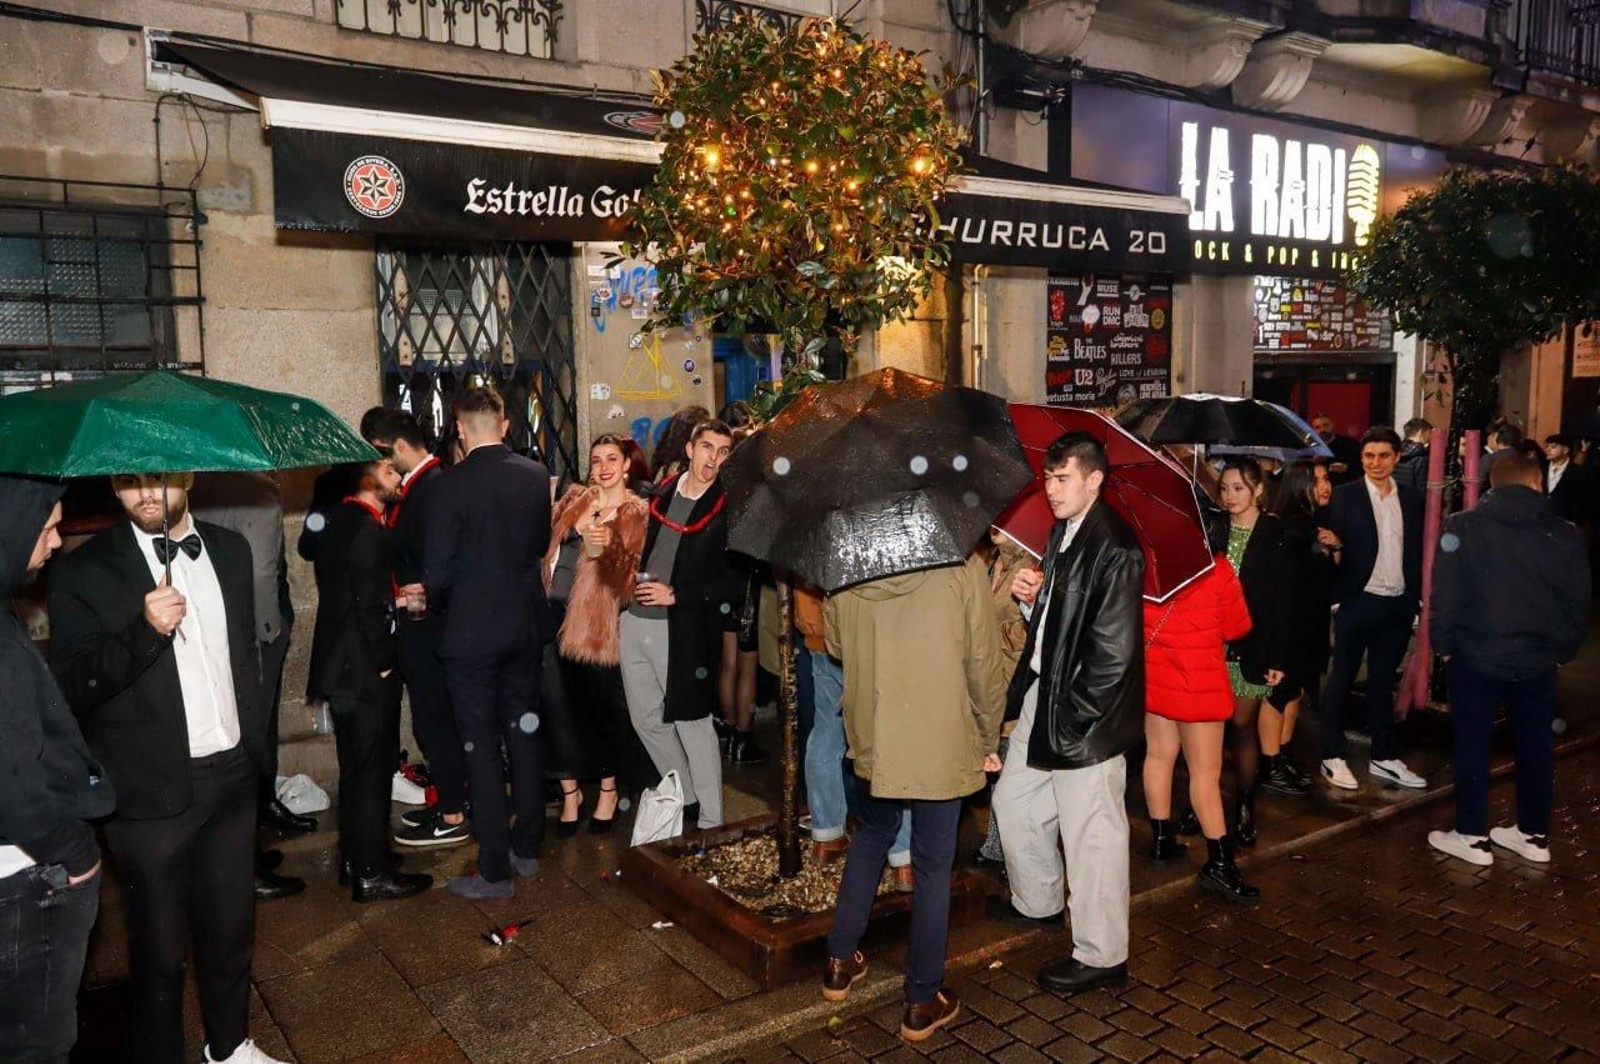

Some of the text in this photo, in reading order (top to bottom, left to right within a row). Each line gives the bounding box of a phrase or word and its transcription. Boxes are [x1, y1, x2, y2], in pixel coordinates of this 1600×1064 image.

[1179, 122, 1235, 232] LA
[464, 177, 584, 218] Estrella
[1129, 230, 1166, 254] 20
[1194, 239, 1230, 261] OCK
[1244, 243, 1253, 263] &
[1267, 245, 1299, 266] POP
[1311, 249, 1320, 268] &
[1097, 284, 1119, 293] MUSE
[1103, 305, 1121, 316] RUN
[1103, 315, 1121, 326] DMC
[1074, 338, 1107, 363] BEATLES
[1074, 368, 1094, 386] U2
